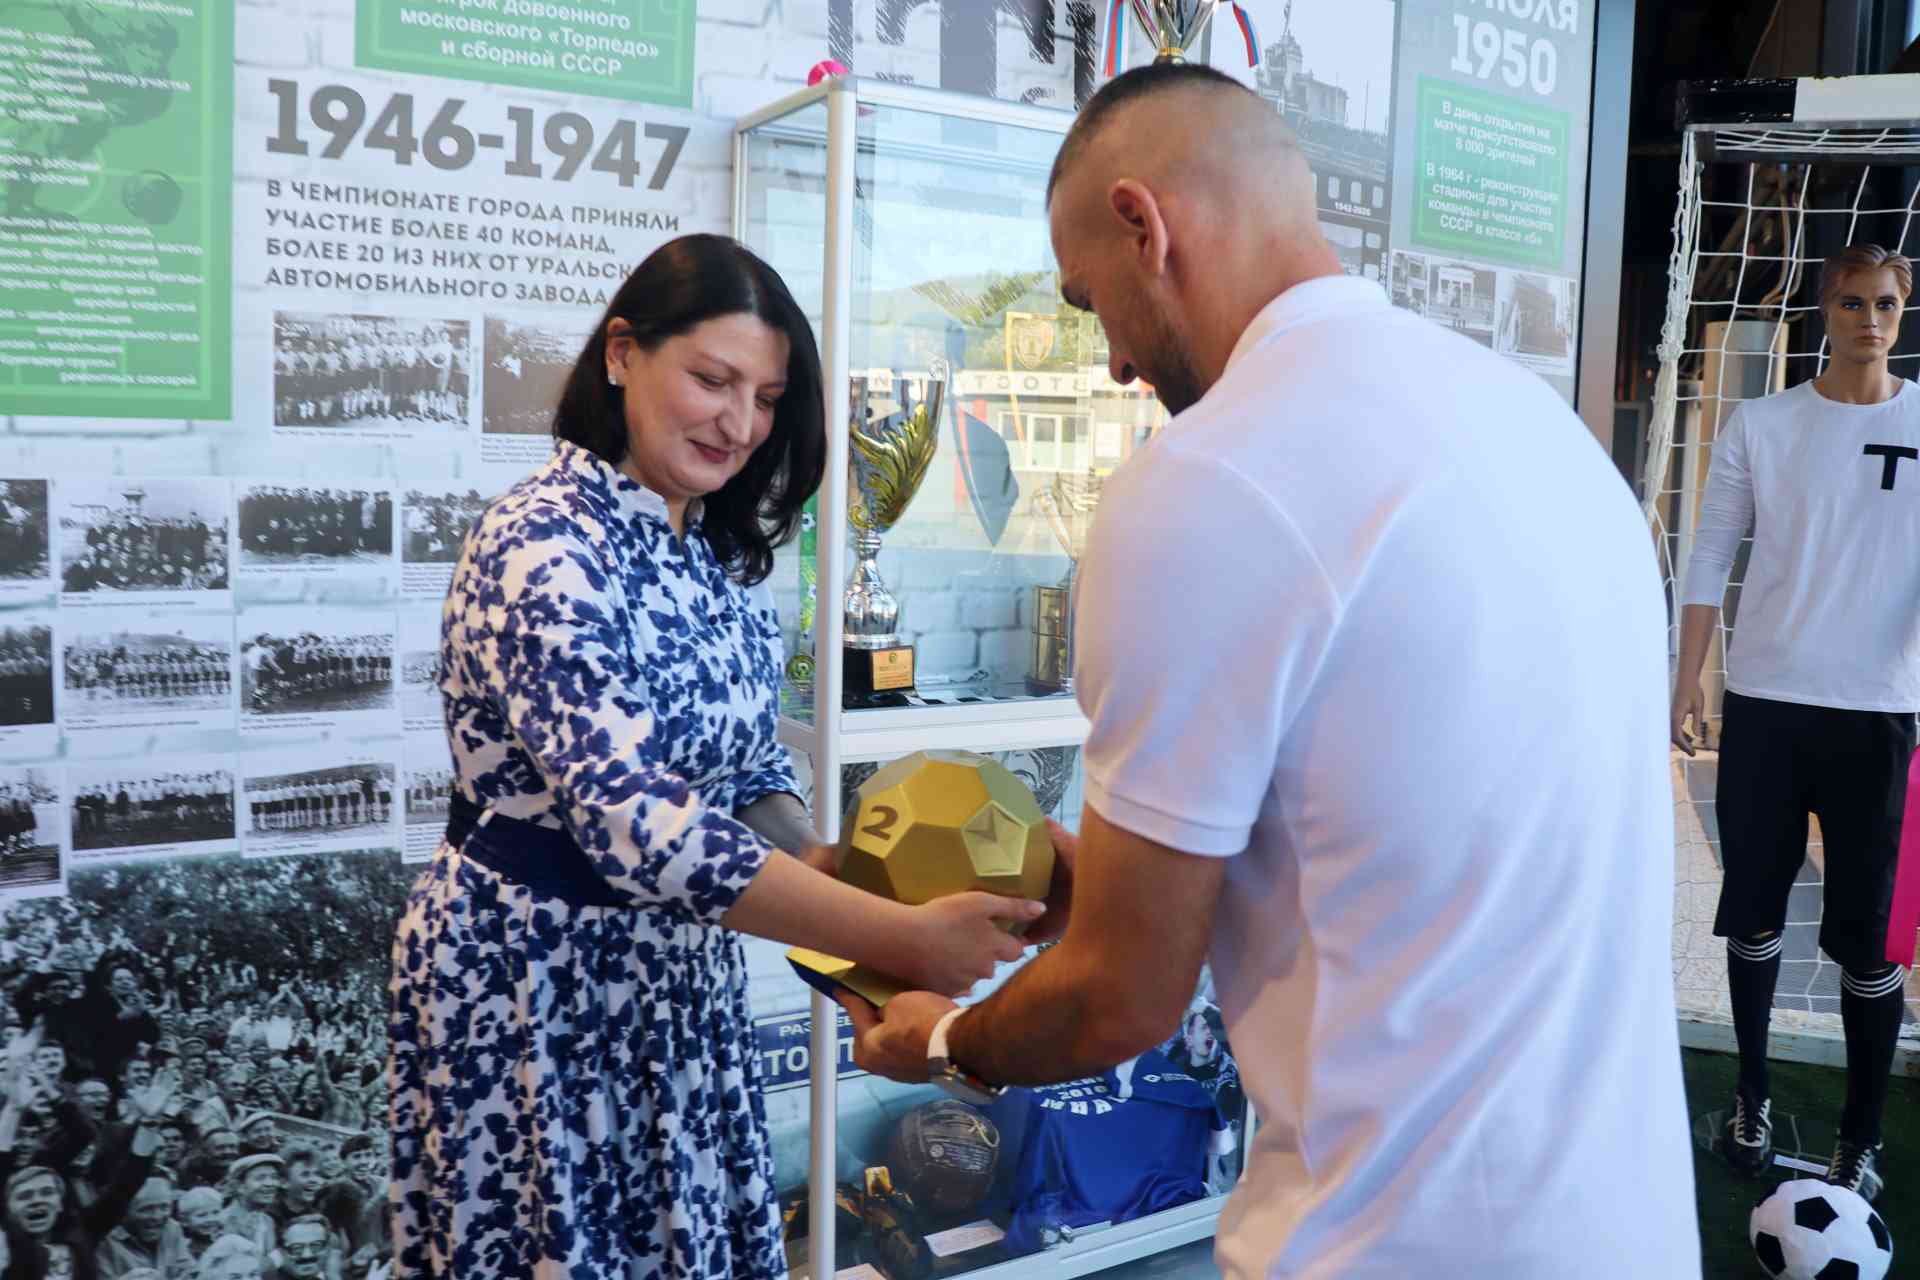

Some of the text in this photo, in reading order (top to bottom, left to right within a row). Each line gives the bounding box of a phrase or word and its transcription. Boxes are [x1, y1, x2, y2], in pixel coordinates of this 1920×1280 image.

[401, 8, 659, 59] московского «Торпедо»
[503, 0, 632, 30] довоенного
[442, 39, 622, 77] и сборной СССР
[1451, 13, 1557, 95] 1950
[1442, 100, 1451, 115] В
[266, 78, 691, 191] 1946-1947
[1426, 162, 1435, 176] В
[267, 179, 680, 231] В ЧЕМПИОНАТЕ ГОРОДА ПРИНЯЛИ
[1440, 214, 1473, 233] СССР
[265, 208, 383, 235] УЧАСТИЕ
[391, 218, 470, 241] БОЛЕЕ
[476, 225, 504, 244] 40
[266, 237, 349, 261] БОЛЕЕ
[357, 244, 384, 263] 20
[393, 246, 424, 266] ИЗ
[432, 249, 481, 270] НИХ
[489, 253, 518, 273] ОТ
[263, 266, 609, 307] АВТОМОБИЛЬНОГО ЗАВОДА
[1863, 443, 1918, 491] Т
[861, 806, 899, 841] 2
